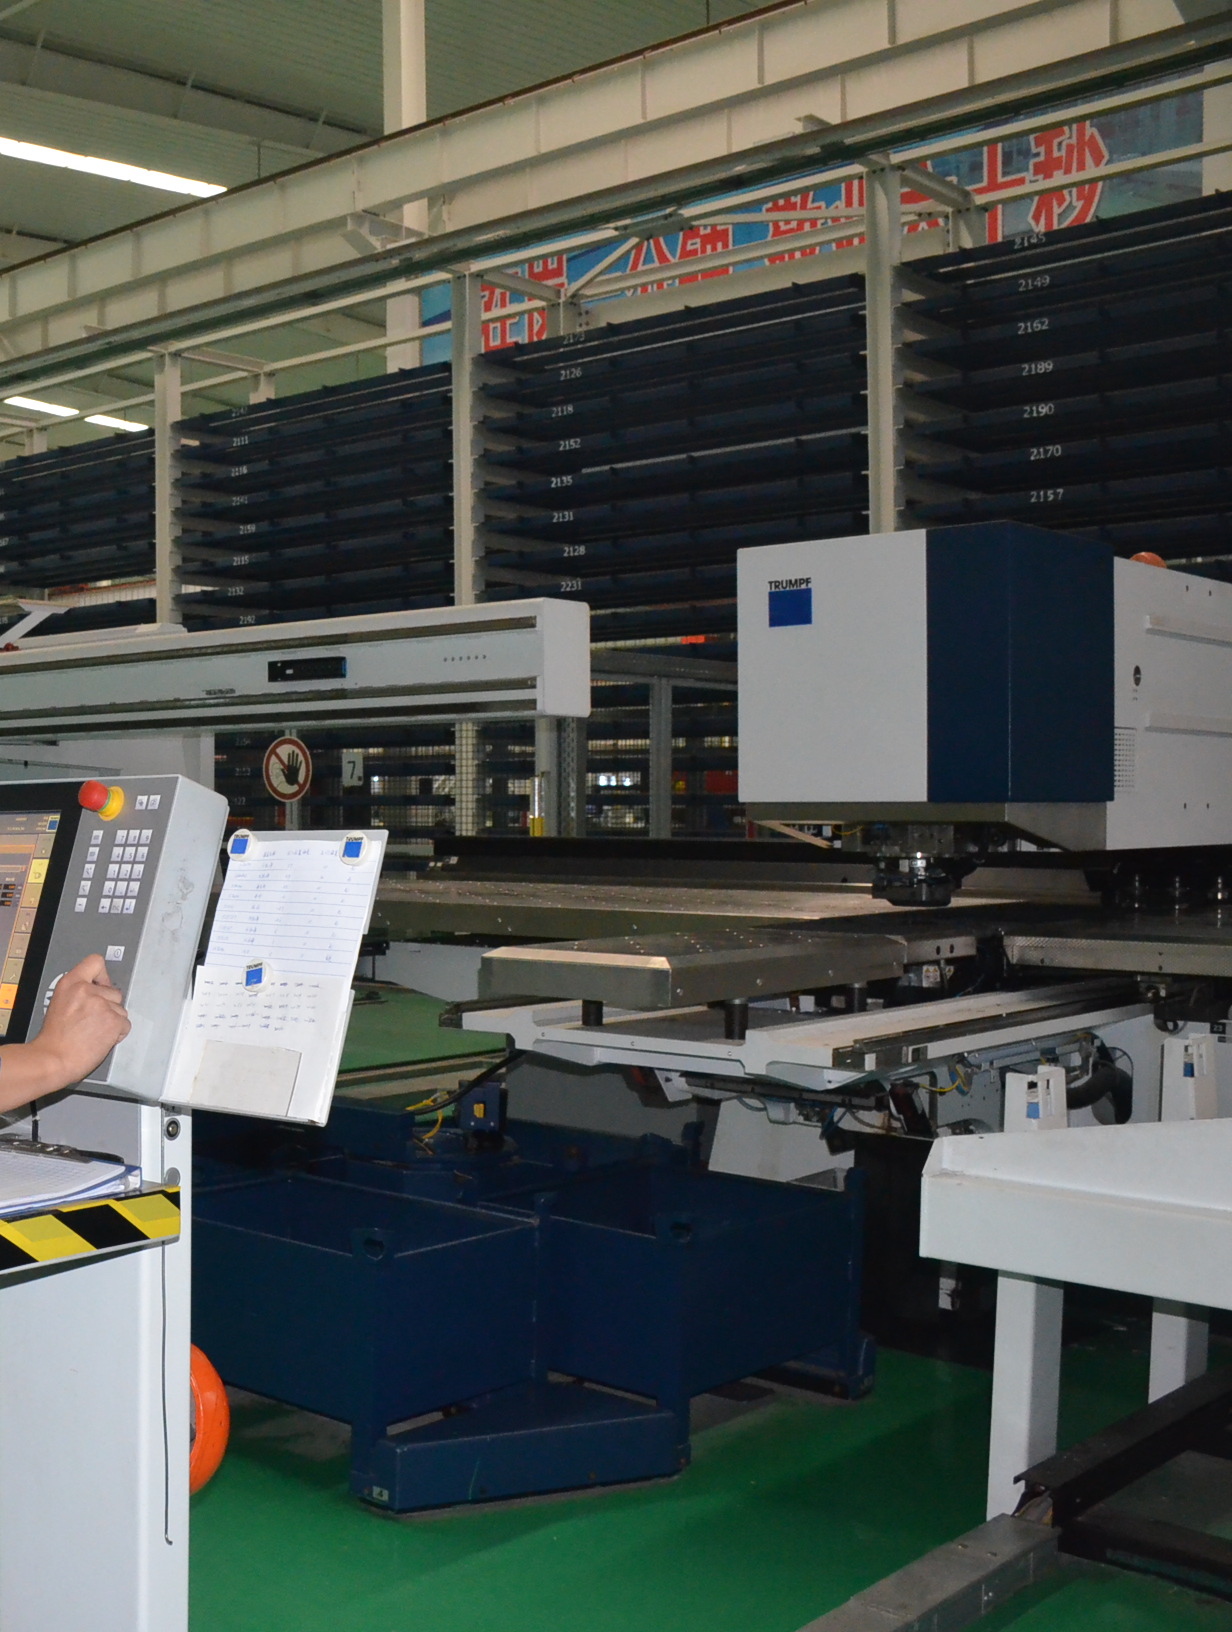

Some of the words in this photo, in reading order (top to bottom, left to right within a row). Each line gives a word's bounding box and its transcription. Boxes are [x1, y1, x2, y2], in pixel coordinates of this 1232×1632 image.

[1014, 233, 1046, 249] 2145
[1018, 275, 1050, 292] 2149
[1017, 318, 1049, 335] 2162
[560, 367, 583, 381] 2126
[1021, 360, 1054, 376] 2189
[551, 404, 574, 417] 2118
[1023, 403, 1055, 418] 2190
[559, 438, 581, 451] 2152
[1030, 445, 1062, 460] 2170
[551, 475, 573, 488] 2135
[1030, 488, 1064, 503] 2157
[552, 511, 574, 523] 2131
[563, 545, 586, 557] 2128
[560, 580, 582, 592] 2231
[768, 577, 812, 591] TRUMPF
[347, 761, 356, 779] 7
